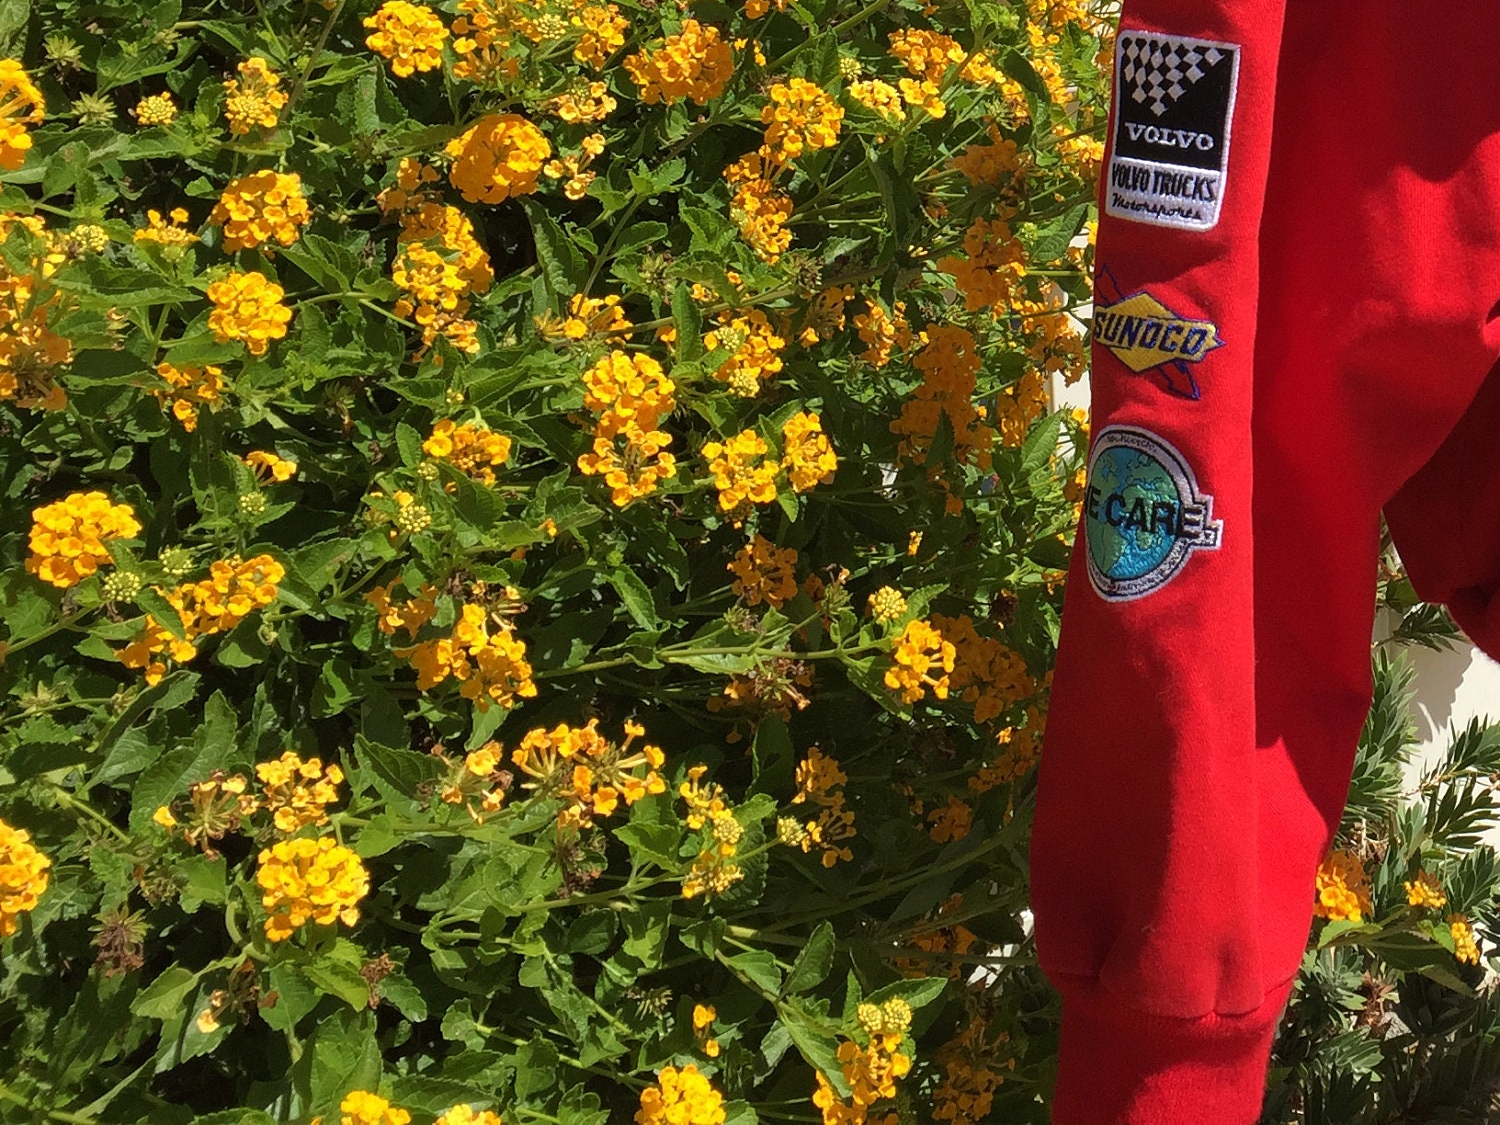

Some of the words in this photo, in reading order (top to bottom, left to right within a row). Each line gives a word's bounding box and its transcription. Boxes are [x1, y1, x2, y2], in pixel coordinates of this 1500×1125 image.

[1124, 122, 1214, 151] VOLVO
[1111, 163, 1150, 193] VOLVO
[1152, 169, 1217, 202] TRUCKS
[1095, 310, 1208, 355] SUNOCO
